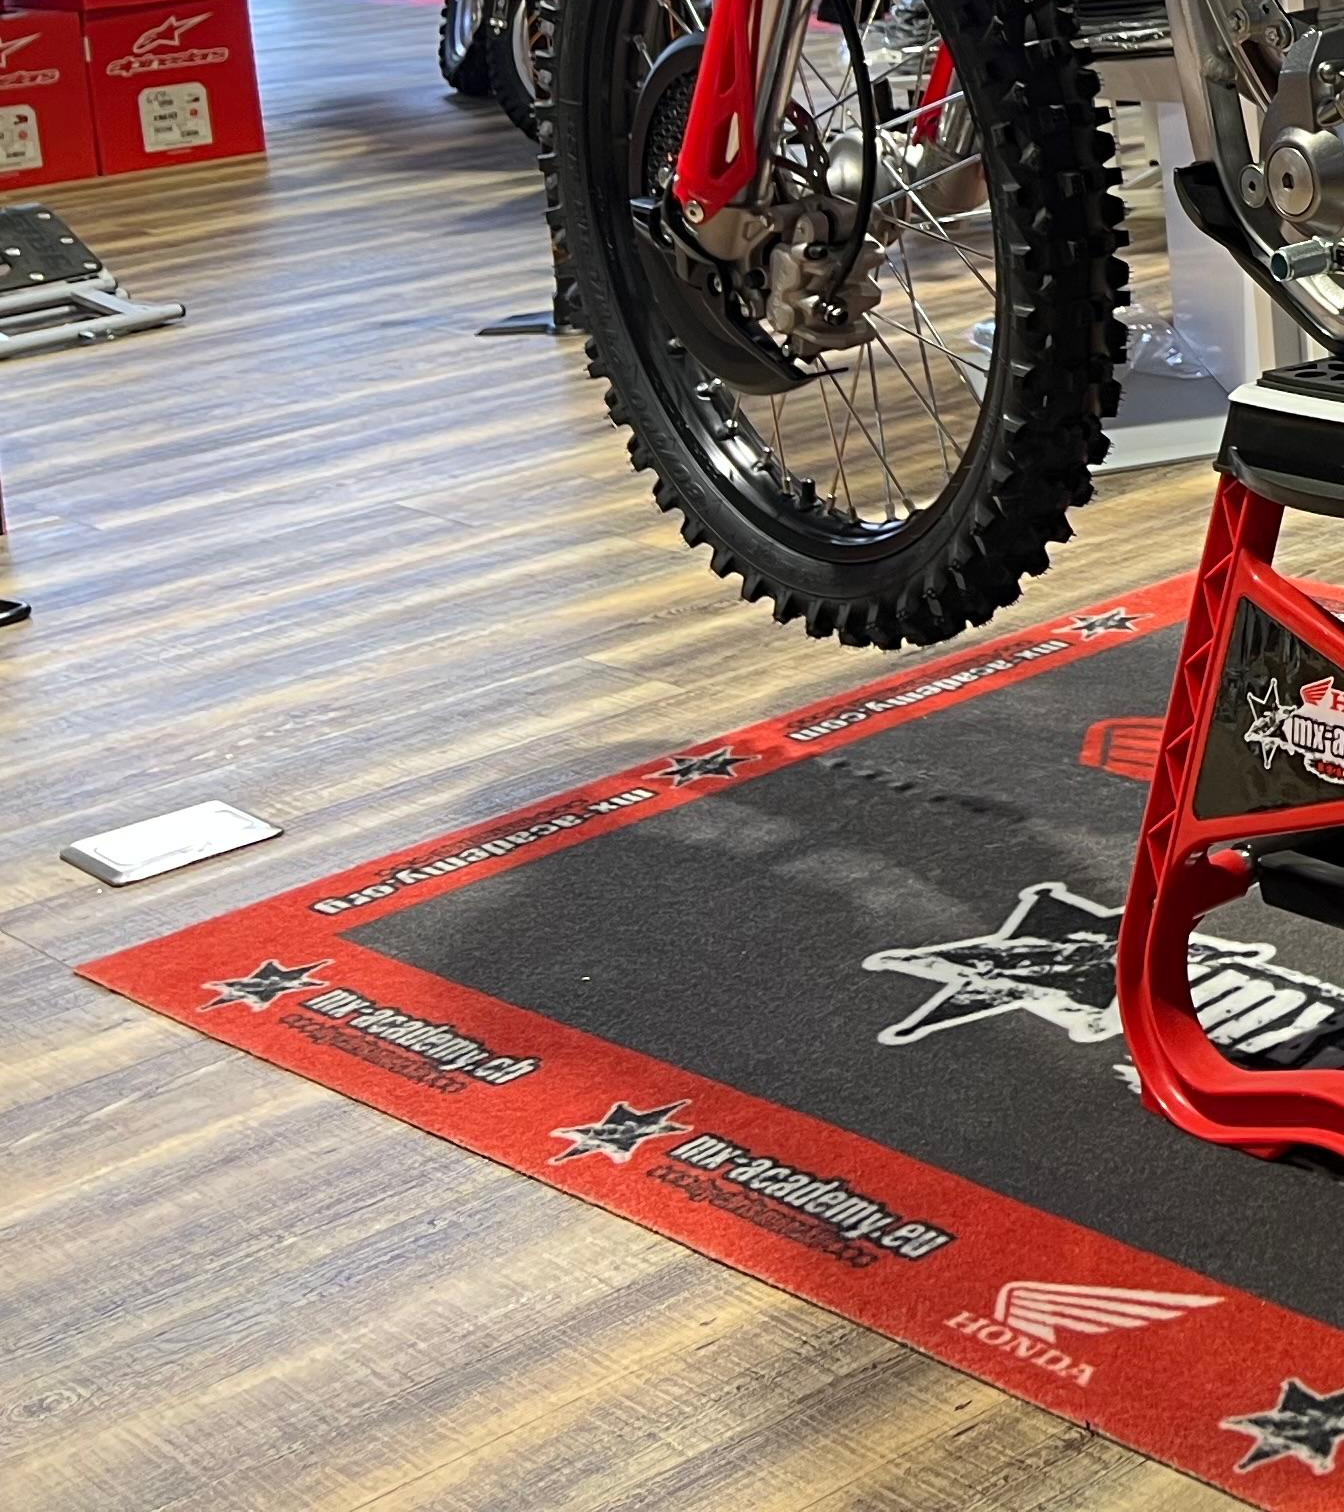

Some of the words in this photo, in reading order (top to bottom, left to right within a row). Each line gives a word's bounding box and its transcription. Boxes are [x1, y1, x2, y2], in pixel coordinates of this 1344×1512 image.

[301, 786, 659, 917] mx-academy.org
[299, 986, 543, 1085] mx-academy.ch
[665, 1132, 959, 1261] mx-academy.eu
[943, 1310, 1096, 1387] HONDA
